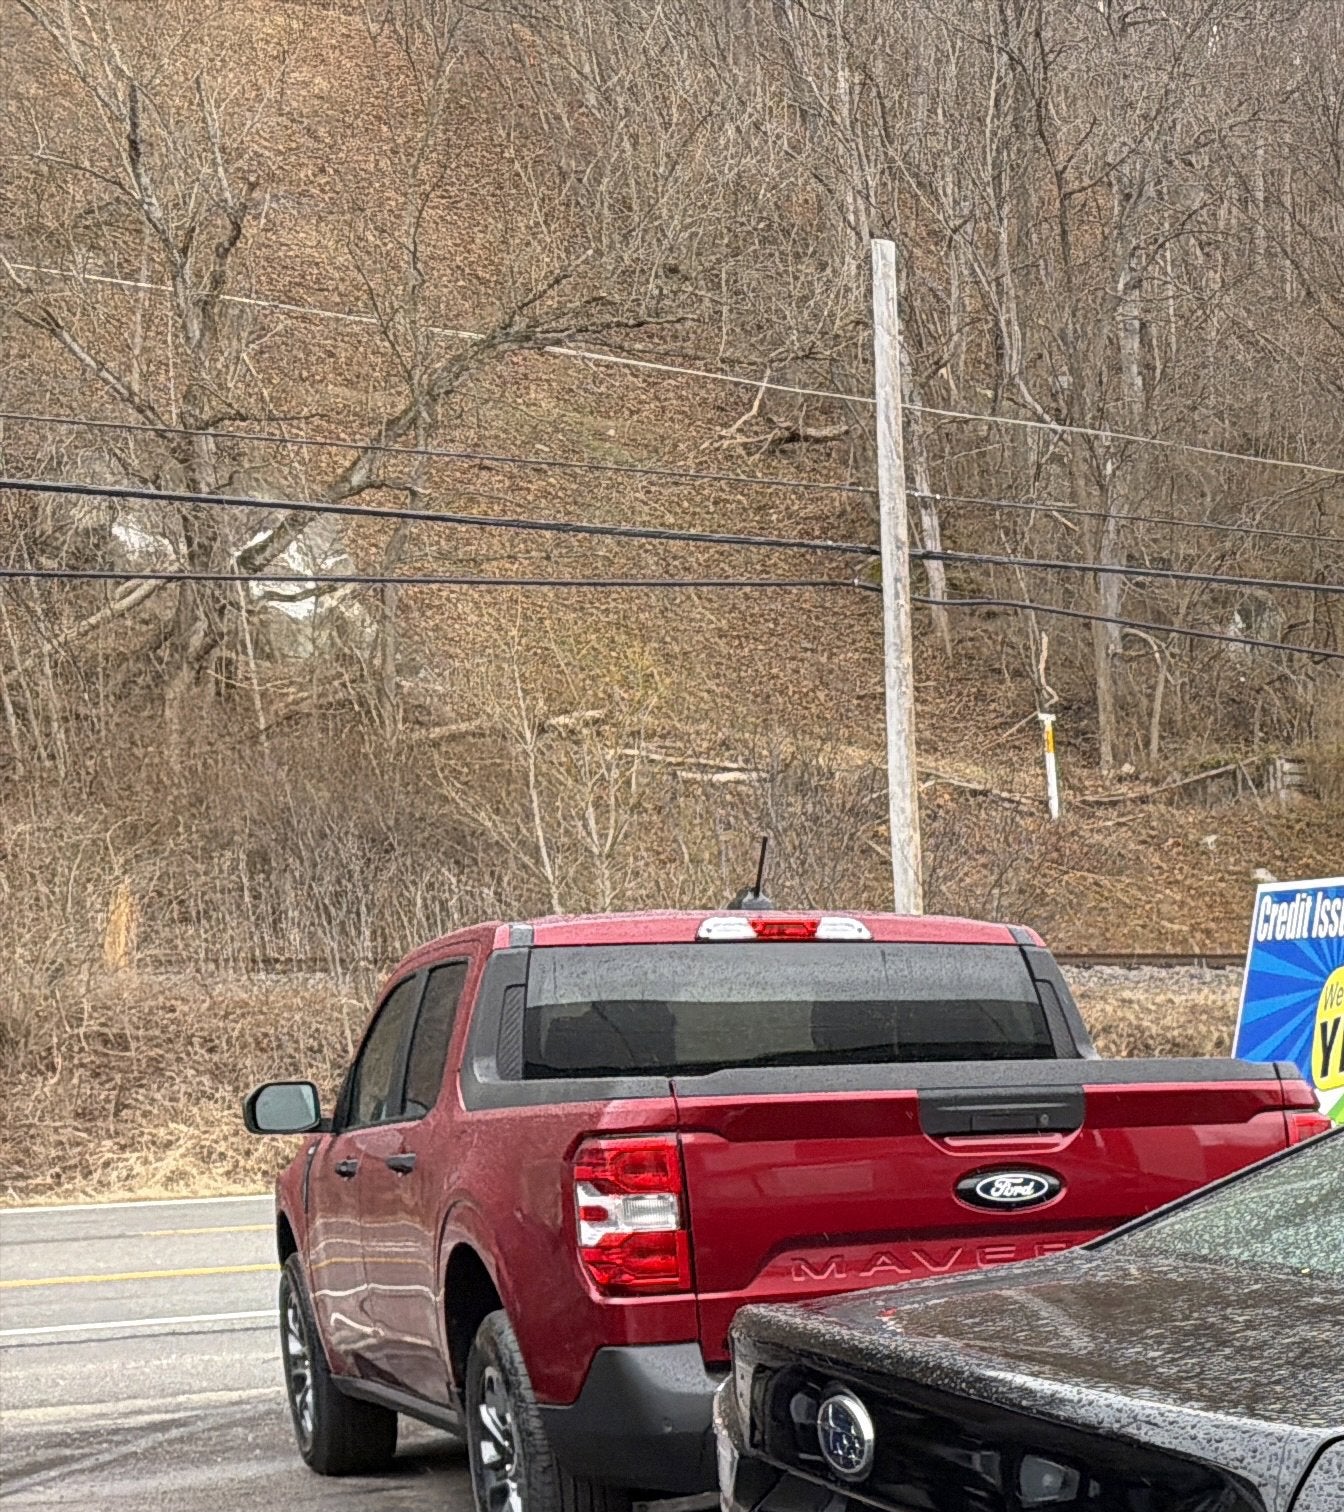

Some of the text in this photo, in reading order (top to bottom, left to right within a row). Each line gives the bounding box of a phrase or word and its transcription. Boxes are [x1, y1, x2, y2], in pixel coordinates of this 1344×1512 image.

[1256, 893, 1311, 942] Credit
[1323, 982, 1344, 1011] We
[990, 1177, 1035, 1197] Ford
